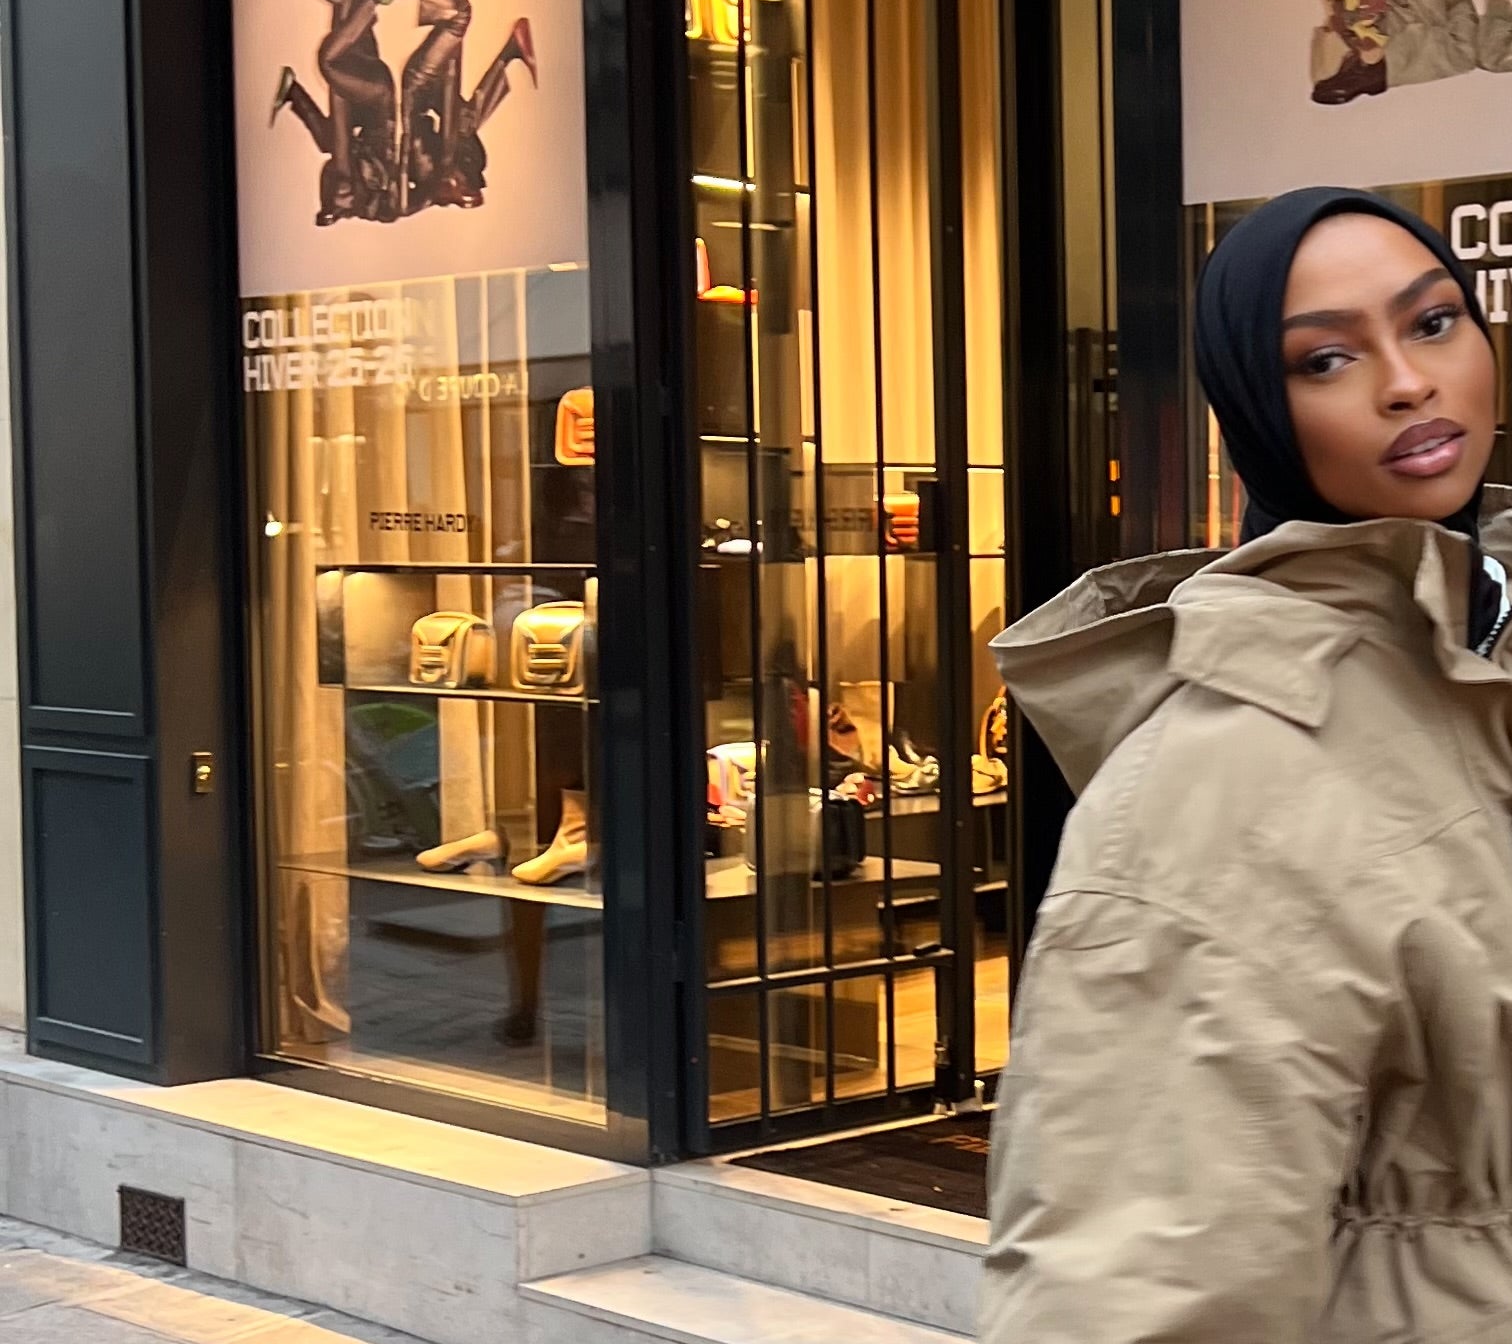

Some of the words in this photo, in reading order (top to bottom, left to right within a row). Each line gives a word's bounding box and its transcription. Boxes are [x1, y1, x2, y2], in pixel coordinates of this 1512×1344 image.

[243, 351, 320, 392] HIVER
[369, 511, 422, 532] PIERRE
[424, 512, 482, 533] HARDY
